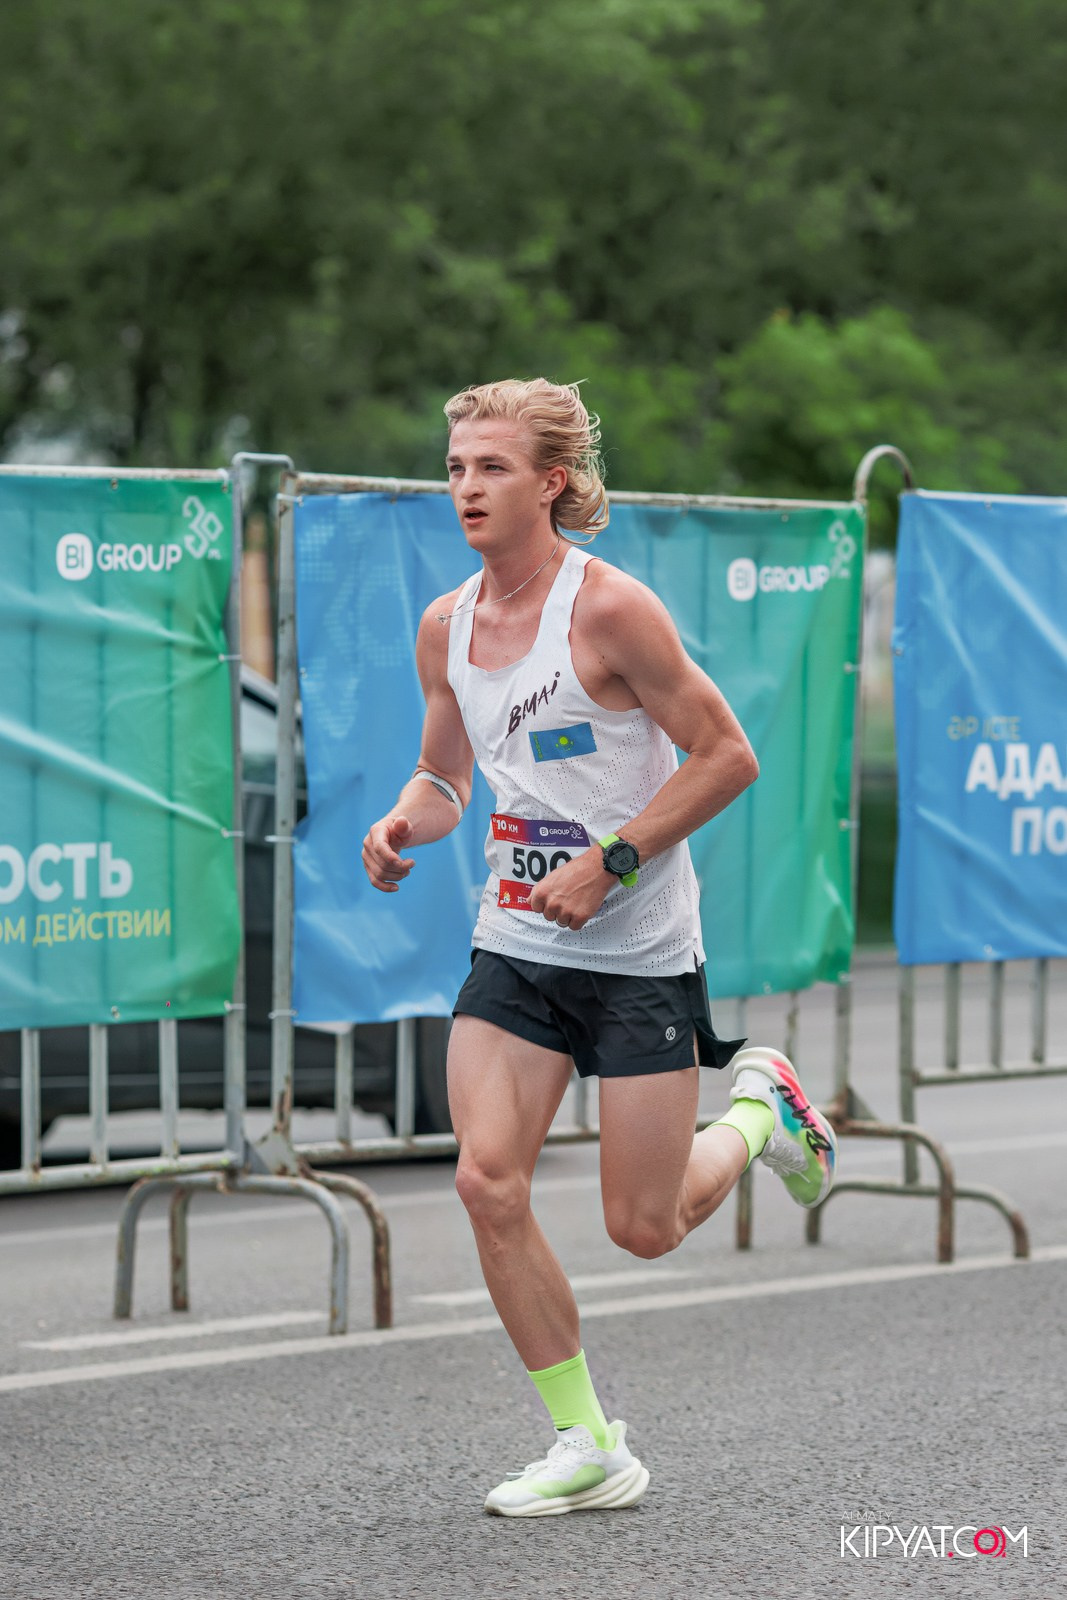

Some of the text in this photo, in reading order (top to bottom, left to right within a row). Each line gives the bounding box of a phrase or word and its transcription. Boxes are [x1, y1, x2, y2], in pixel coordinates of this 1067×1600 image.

[97, 543, 182, 571] GROUP
[759, 565, 830, 592] GROUP
[965, 742, 1067, 801] АДА
[497, 820, 507, 831] 10
[0, 842, 133, 904] ОСТЬ
[33, 907, 171, 948] ДЕЙСТВИИ
